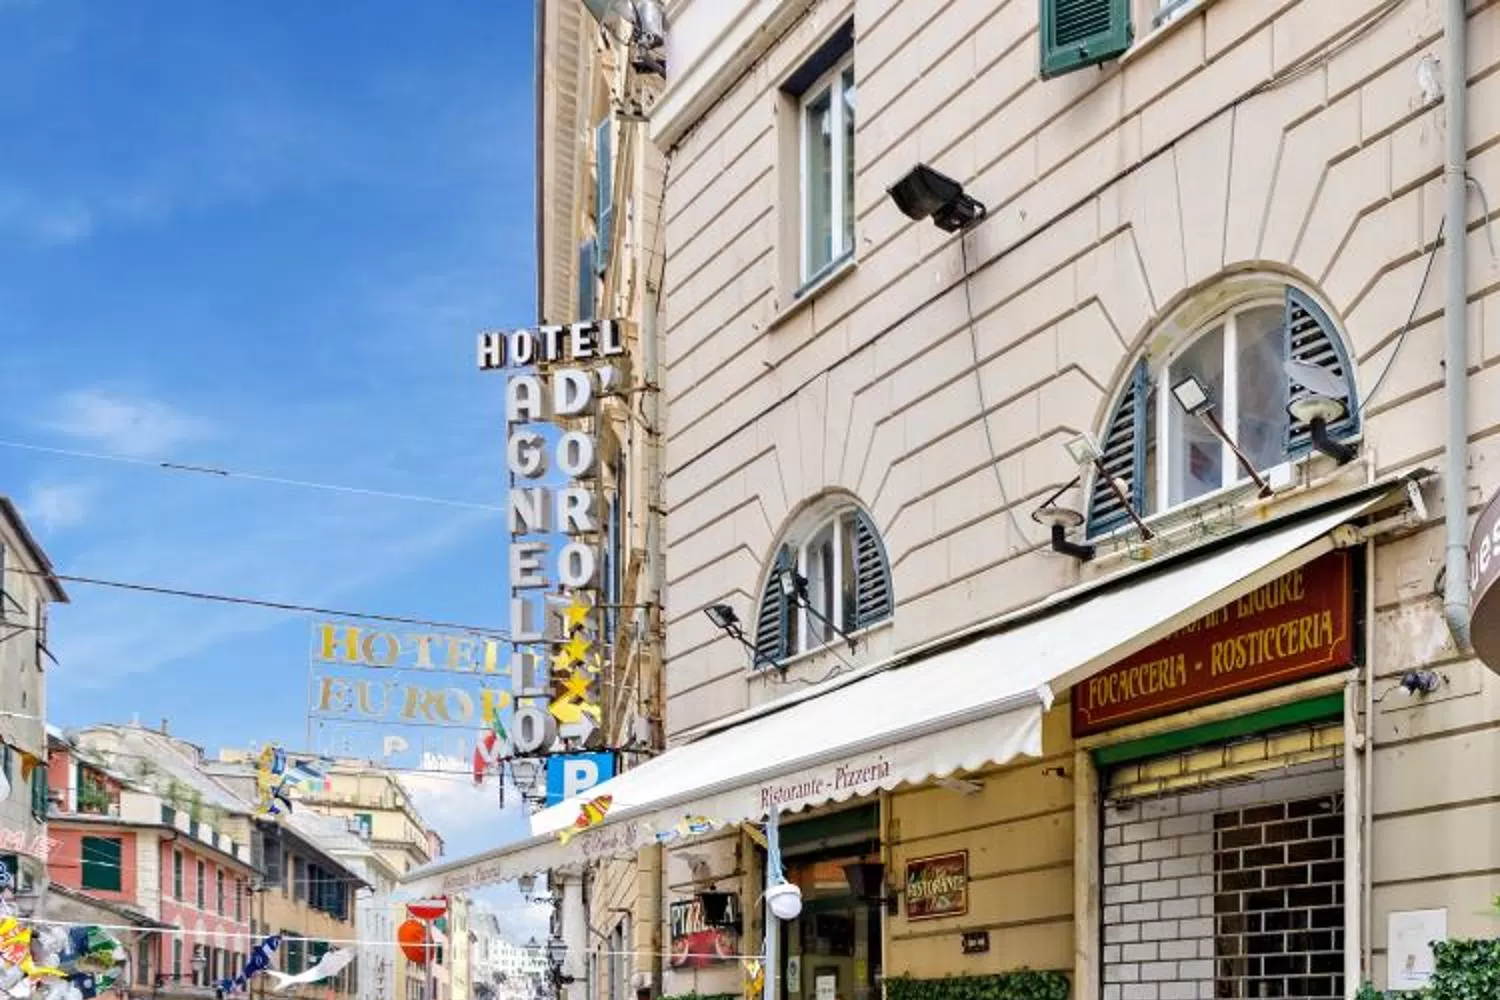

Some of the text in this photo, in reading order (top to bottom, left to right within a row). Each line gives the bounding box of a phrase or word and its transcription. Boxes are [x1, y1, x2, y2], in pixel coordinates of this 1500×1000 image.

[477, 319, 623, 368] HOTEL
[507, 375, 556, 753] AGNELLO
[320, 621, 513, 675] HOTEL
[1088, 653, 1187, 709] FOCACCERIA
[1210, 610, 1334, 677] ROSTICCERIA
[319, 675, 536, 724] EUROP
[564, 759, 599, 800] P
[760, 778, 823, 808] Ristorante
[834, 755, 890, 790] Pizzeria
